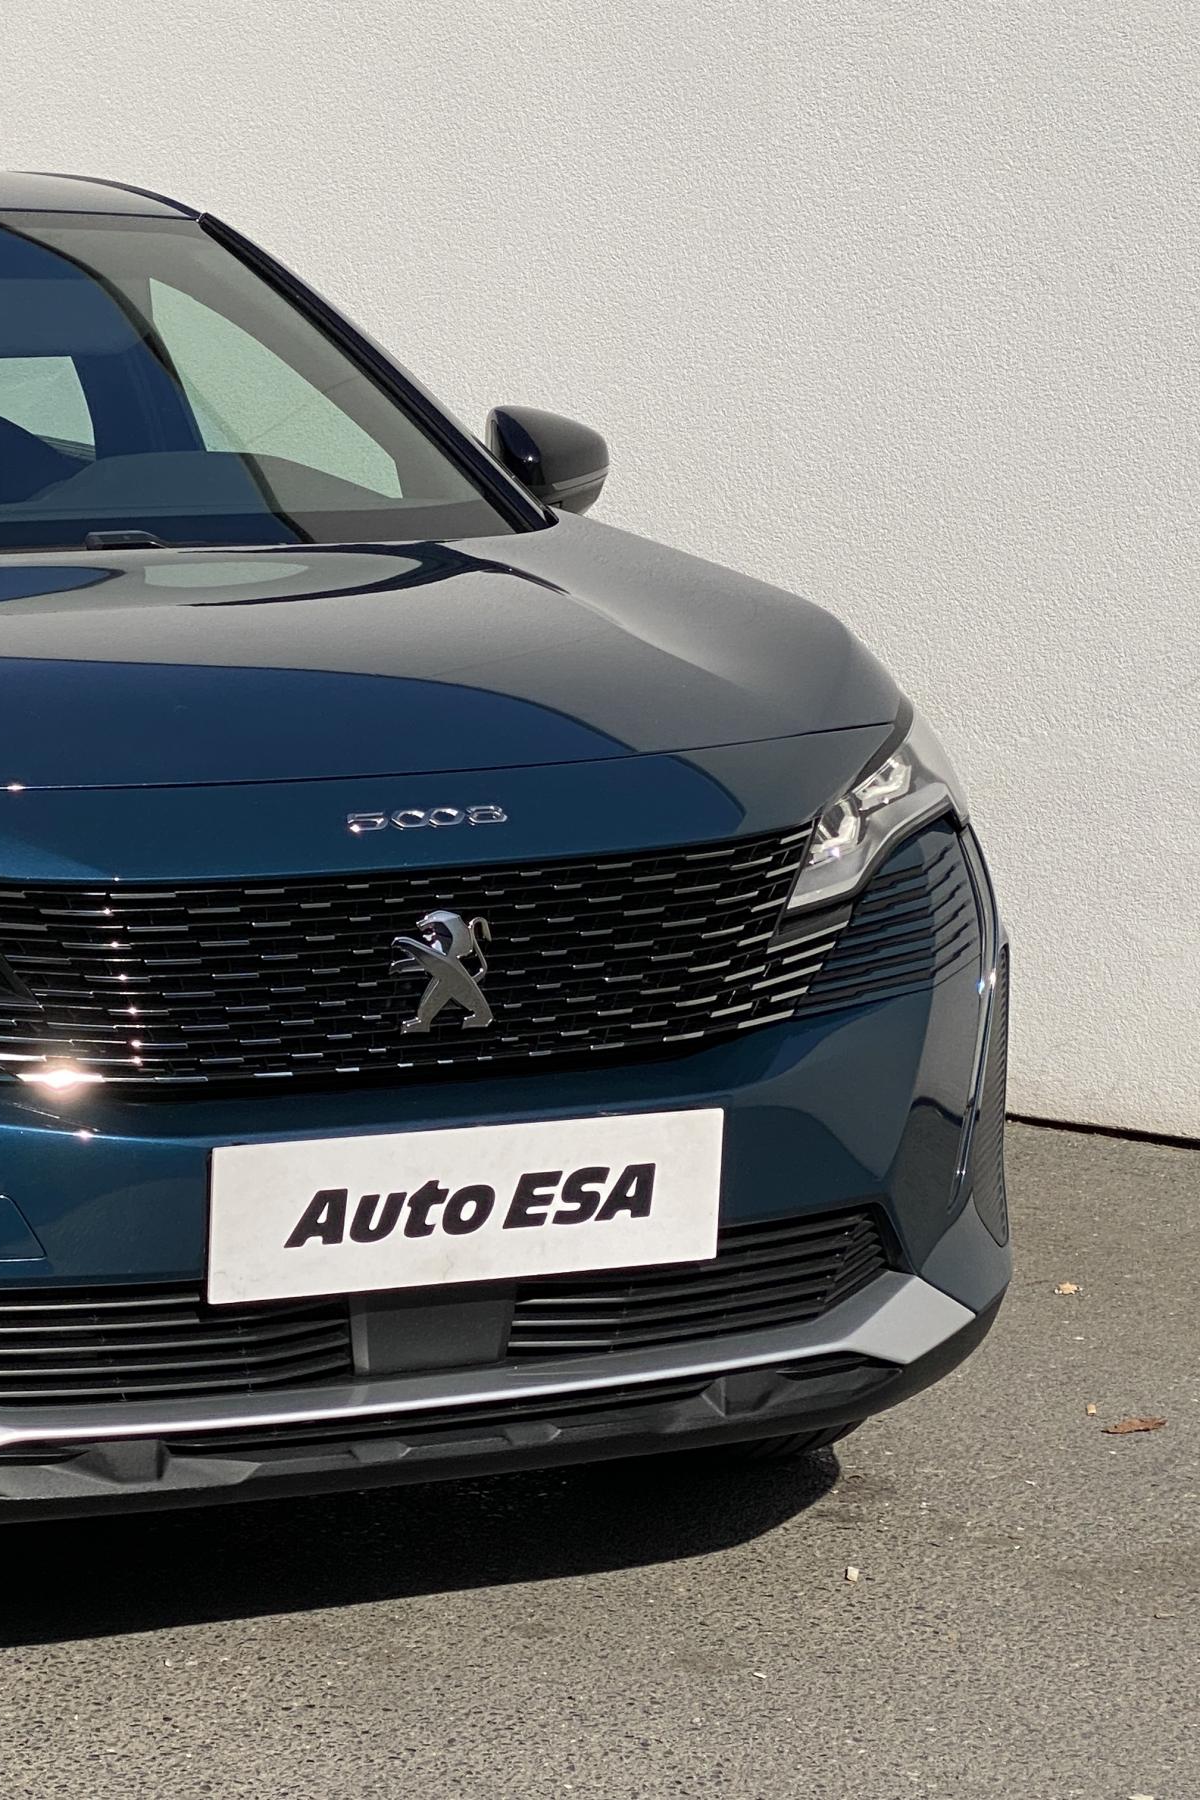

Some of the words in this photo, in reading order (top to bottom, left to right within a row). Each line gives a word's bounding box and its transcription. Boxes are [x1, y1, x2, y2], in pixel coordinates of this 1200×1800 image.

[347, 805, 508, 833] 5008
[284, 1180, 496, 1248] Auto
[502, 1163, 656, 1230] ESA
